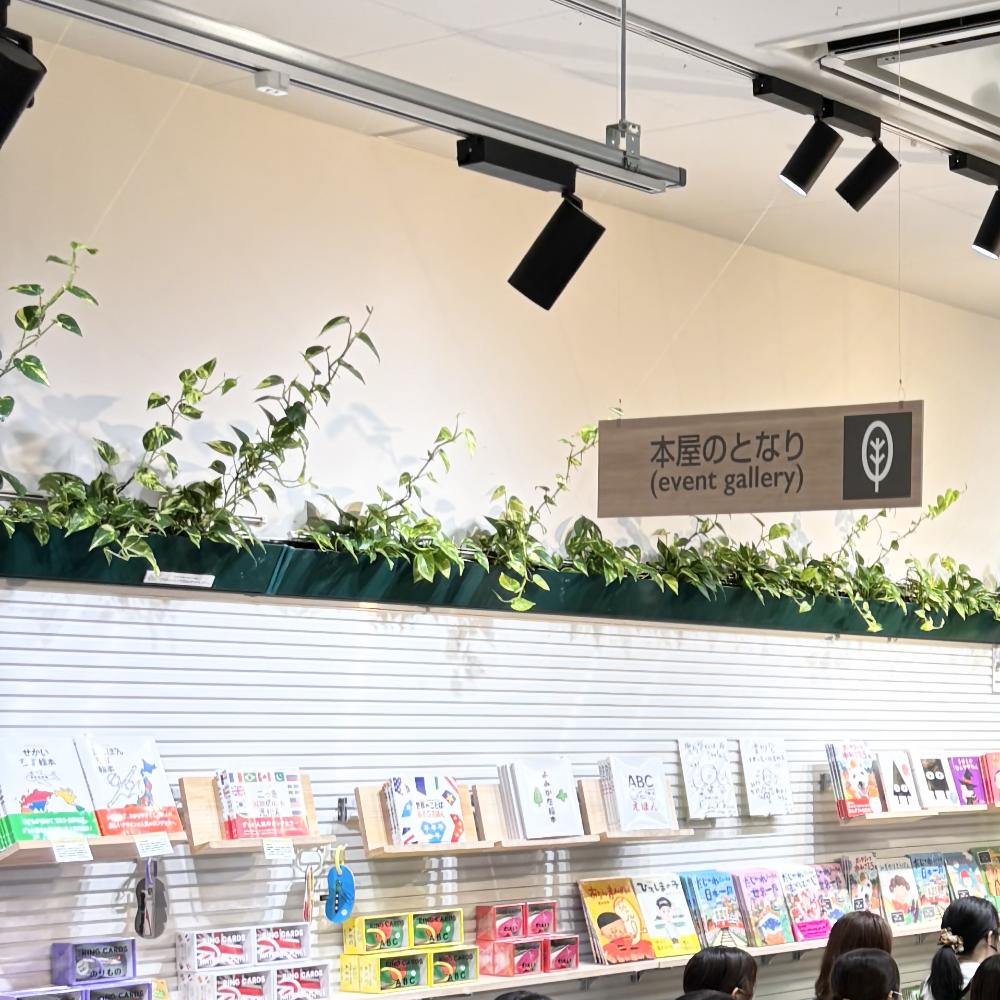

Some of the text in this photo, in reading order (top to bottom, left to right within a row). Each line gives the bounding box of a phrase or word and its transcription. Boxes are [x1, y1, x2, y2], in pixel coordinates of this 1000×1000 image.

[650, 430, 804, 468] 本屋のとなり
[651, 464, 804, 498] (event gallery)
[628, 774, 654, 788] ABC
